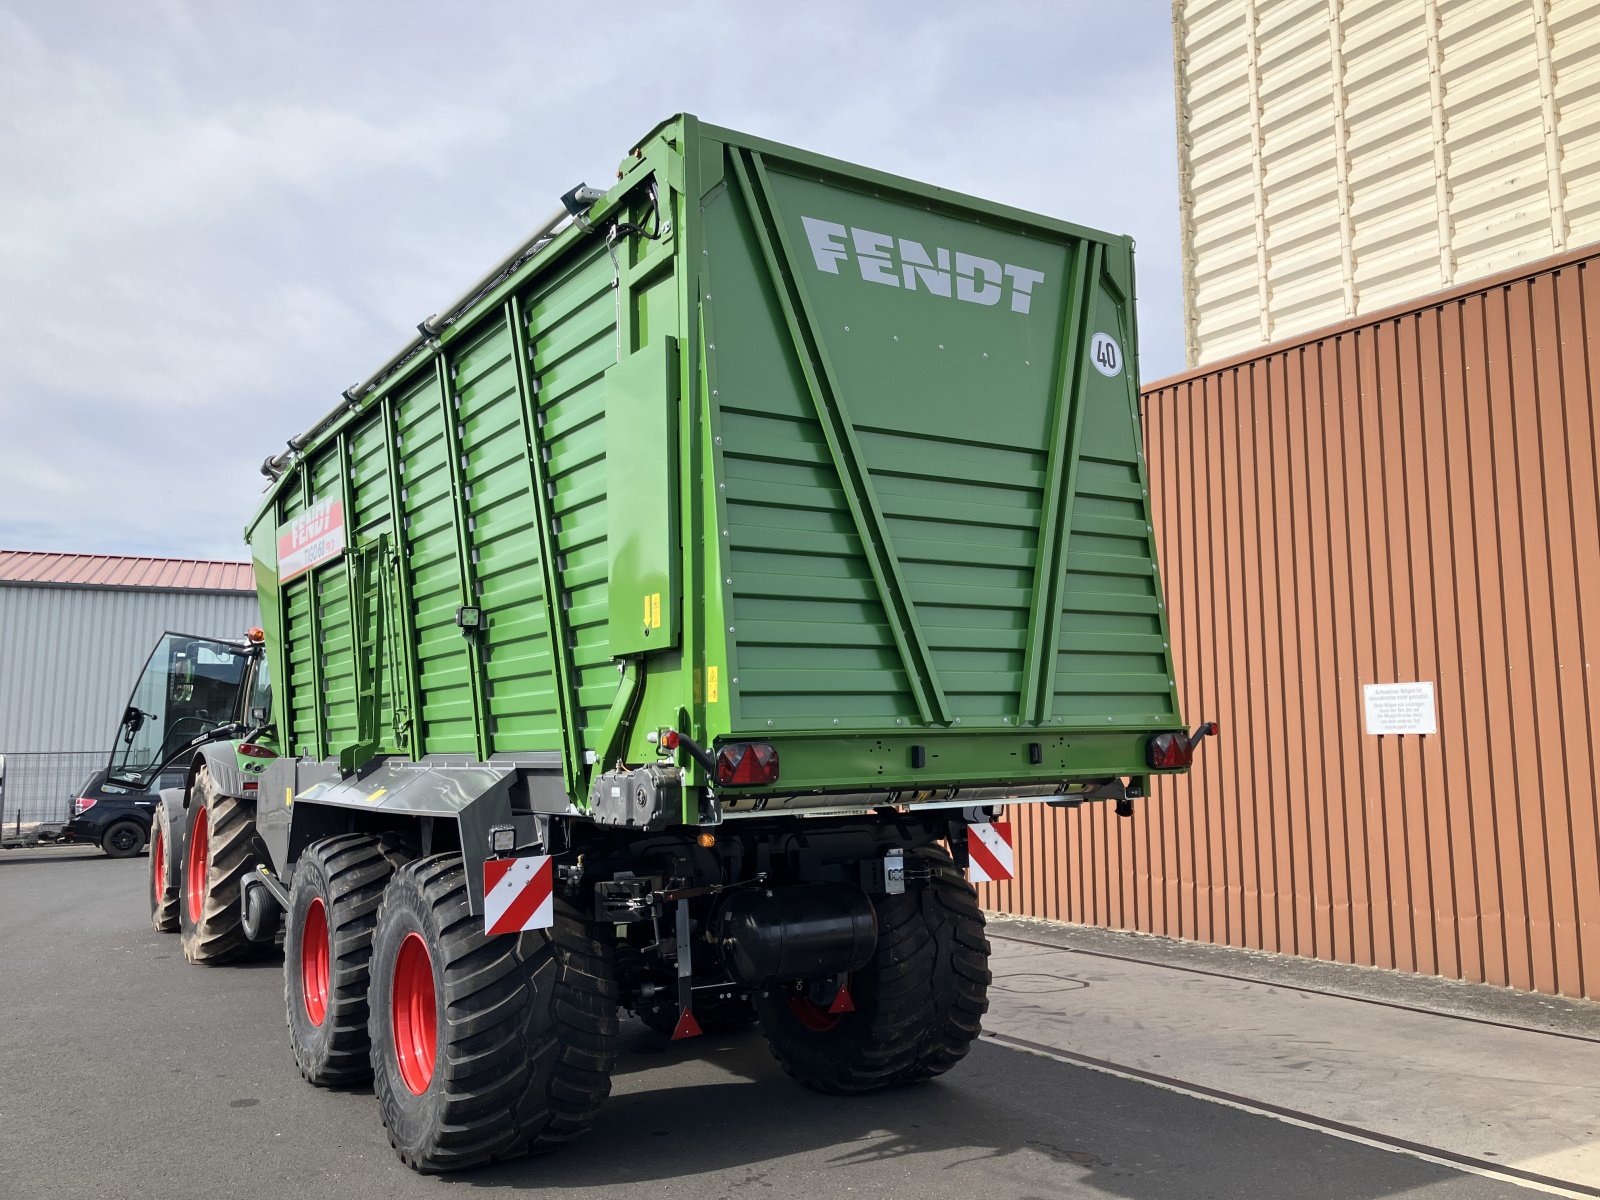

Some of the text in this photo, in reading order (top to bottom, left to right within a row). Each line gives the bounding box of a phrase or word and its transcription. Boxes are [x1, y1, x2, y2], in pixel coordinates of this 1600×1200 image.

[801, 216, 1045, 314] FENDT
[1097, 340, 1116, 369] 40
[291, 496, 334, 549] FENDT
